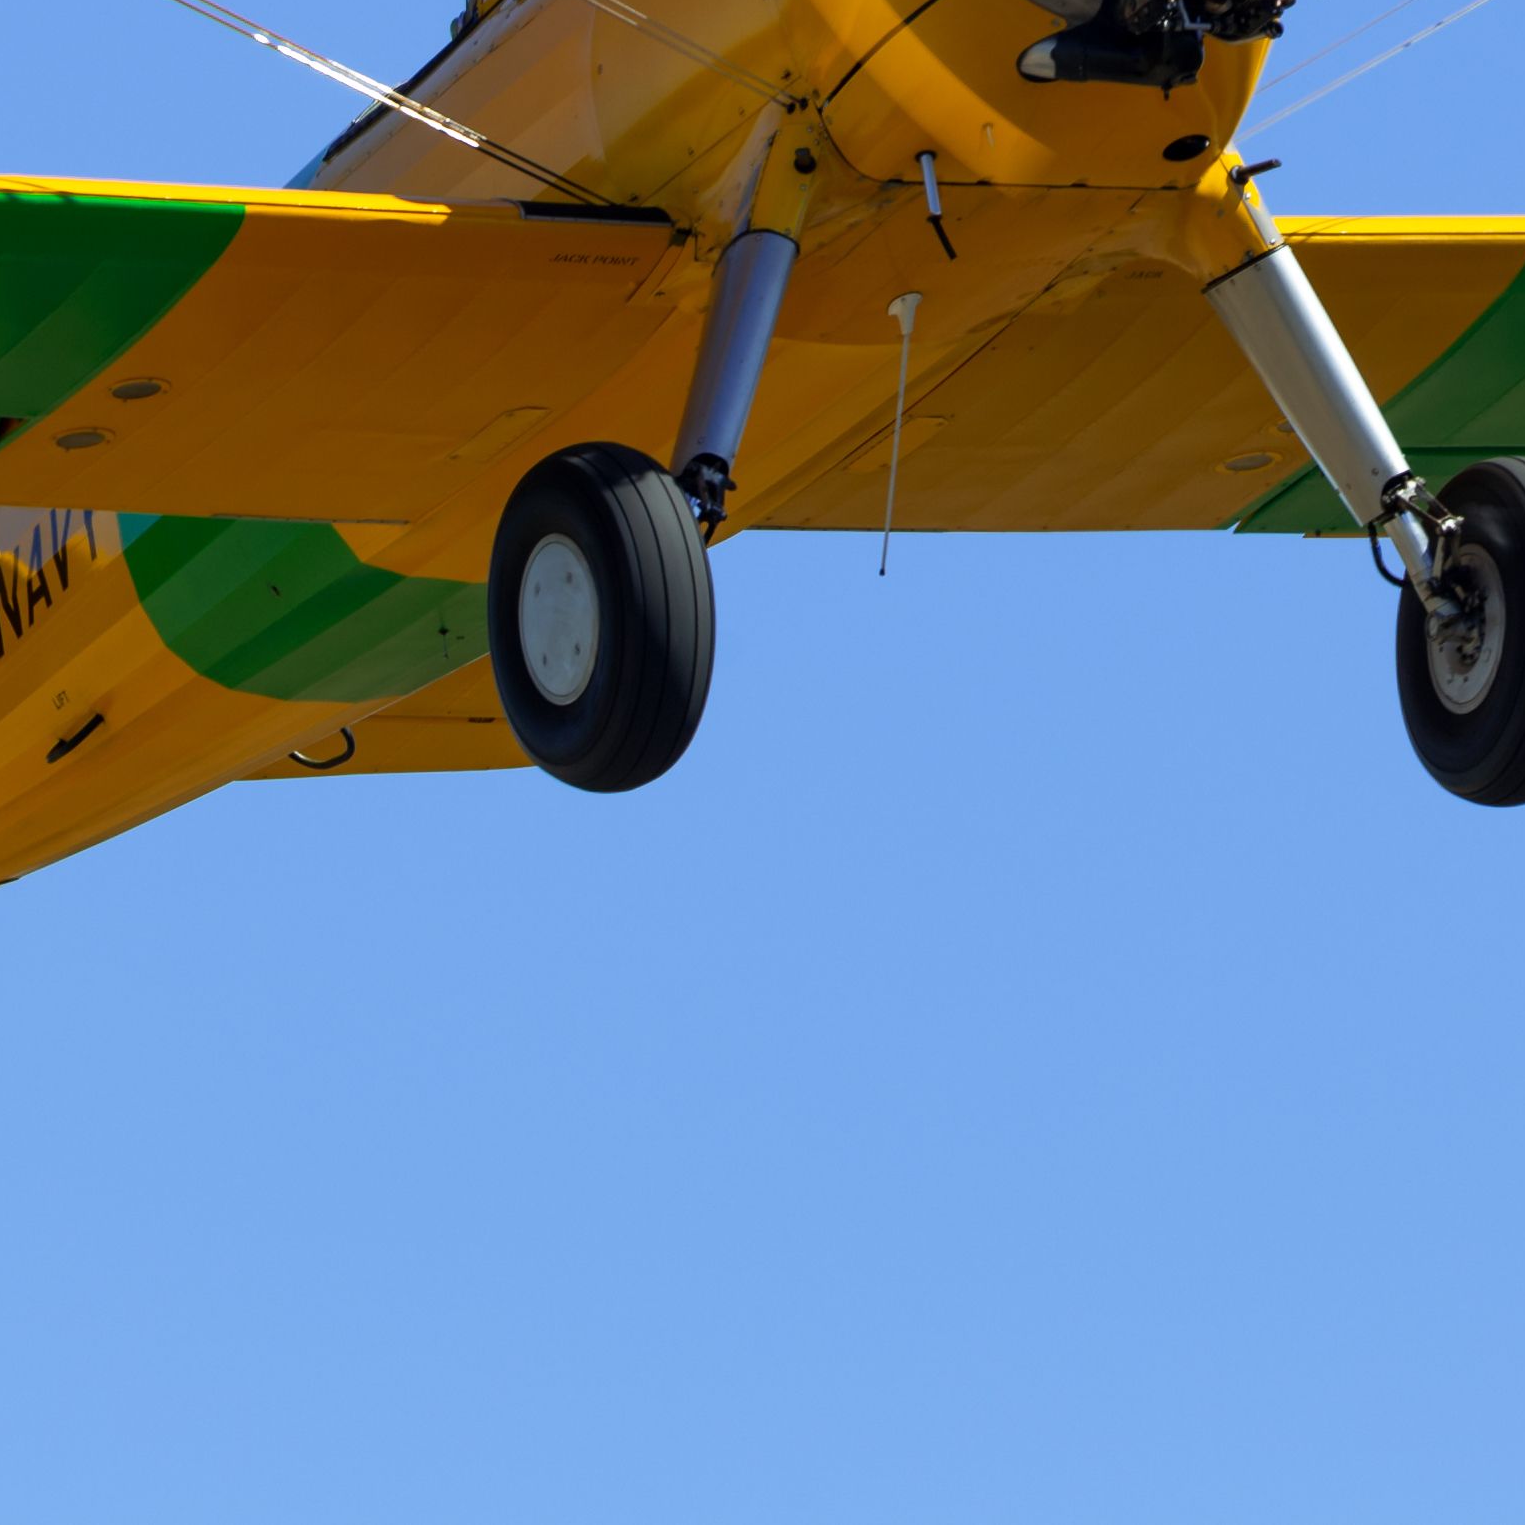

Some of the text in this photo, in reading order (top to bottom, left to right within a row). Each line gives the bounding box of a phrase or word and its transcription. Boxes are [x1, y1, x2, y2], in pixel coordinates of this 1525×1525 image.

[548, 253, 640, 267] JACK POINT
[51, 689, 71, 710] LIFT
